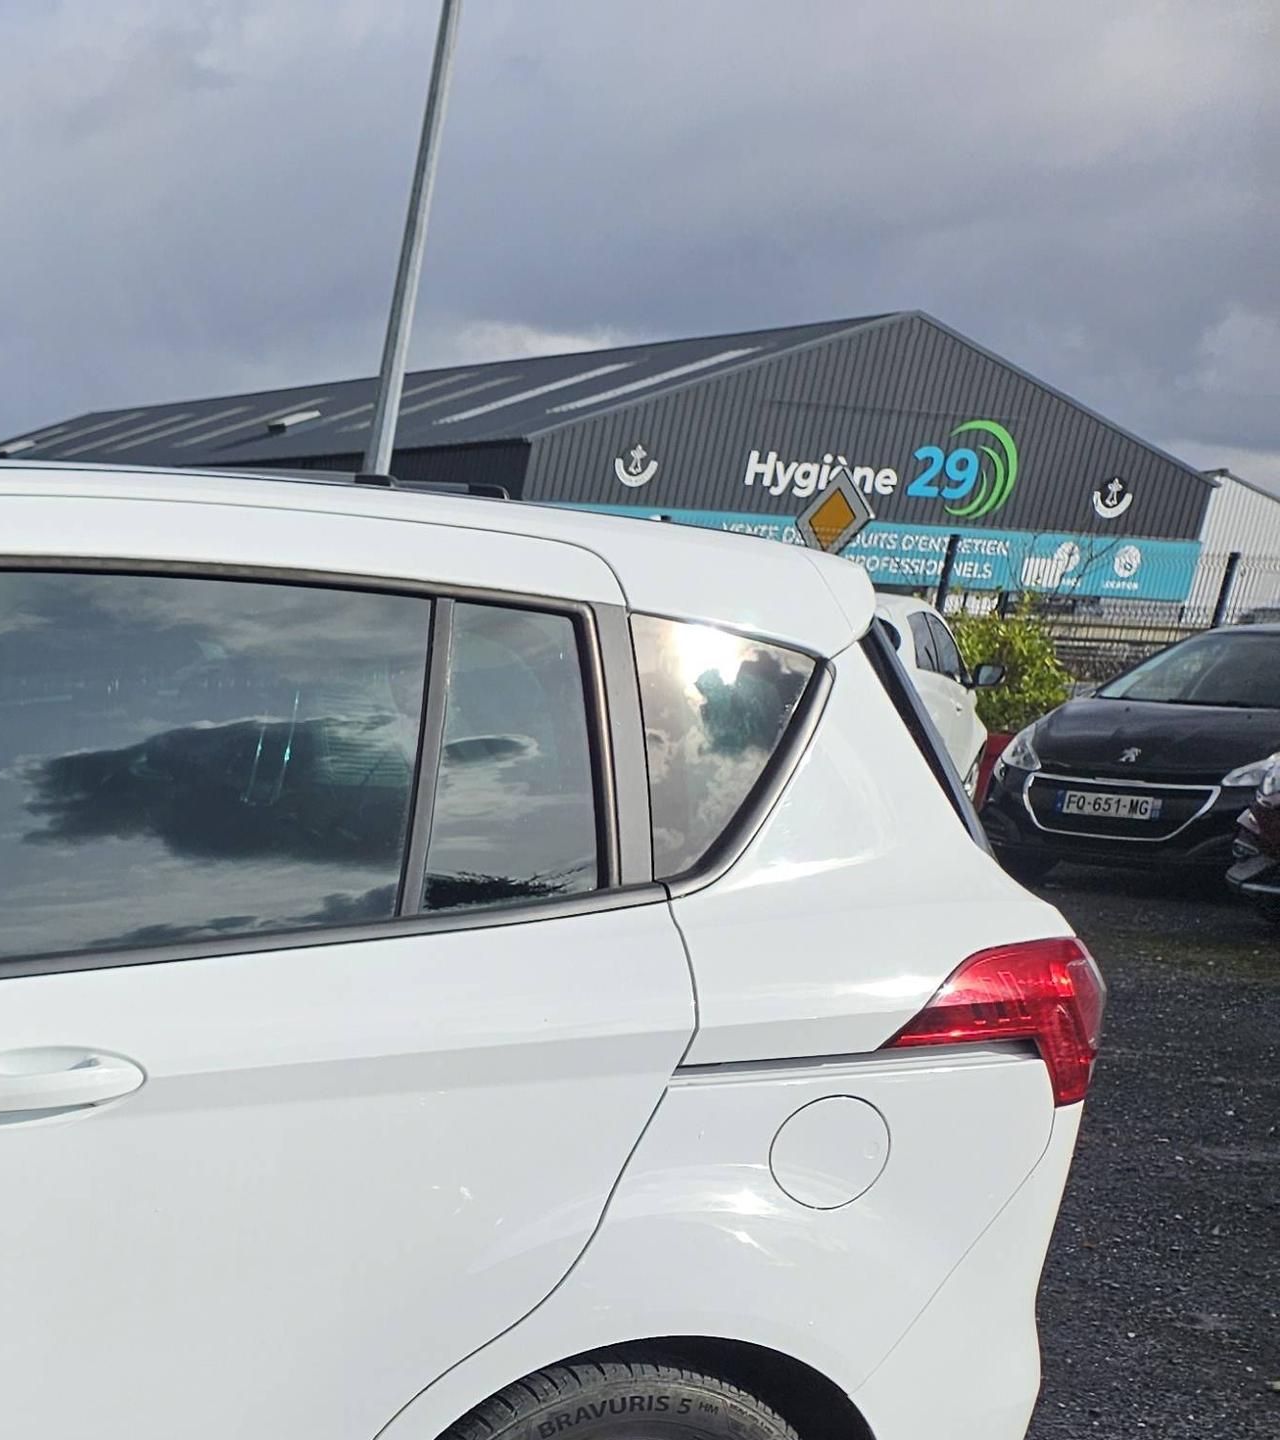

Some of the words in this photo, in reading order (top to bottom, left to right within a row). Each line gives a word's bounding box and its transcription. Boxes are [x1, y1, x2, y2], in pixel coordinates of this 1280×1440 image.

[907, 445, 980, 500] 29
[845, 554, 992, 579] OFESSIONELS
[538, 1394, 670, 1439] BRAVURIS
[676, 1398, 693, 1415] 5
[697, 1401, 720, 1416] HM
